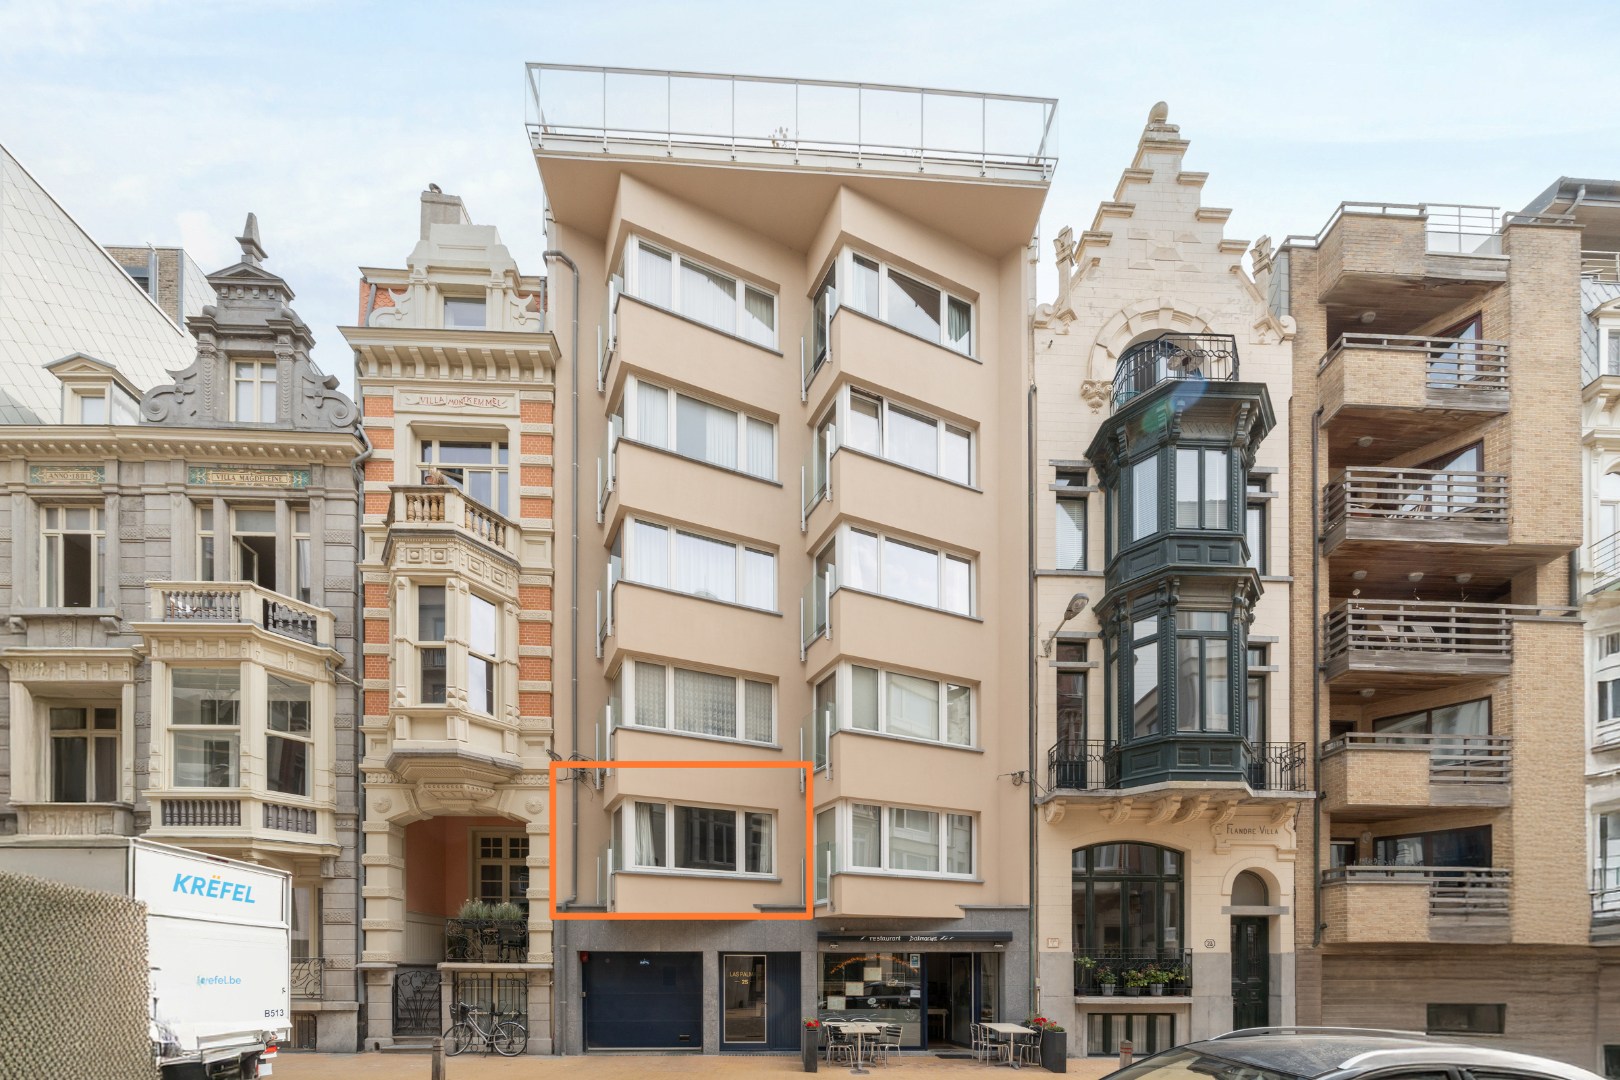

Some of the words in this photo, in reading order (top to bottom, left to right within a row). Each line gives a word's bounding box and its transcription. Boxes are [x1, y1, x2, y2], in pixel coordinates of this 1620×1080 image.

[419, 396, 444, 404] VILLA
[48, 472, 69, 480] ANNO
[1226, 823, 1257, 835] FLANDRE
[1258, 824, 1279, 835] VILLA
[172, 873, 256, 904] KRËFEL
[264, 1008, 285, 1018] B513
